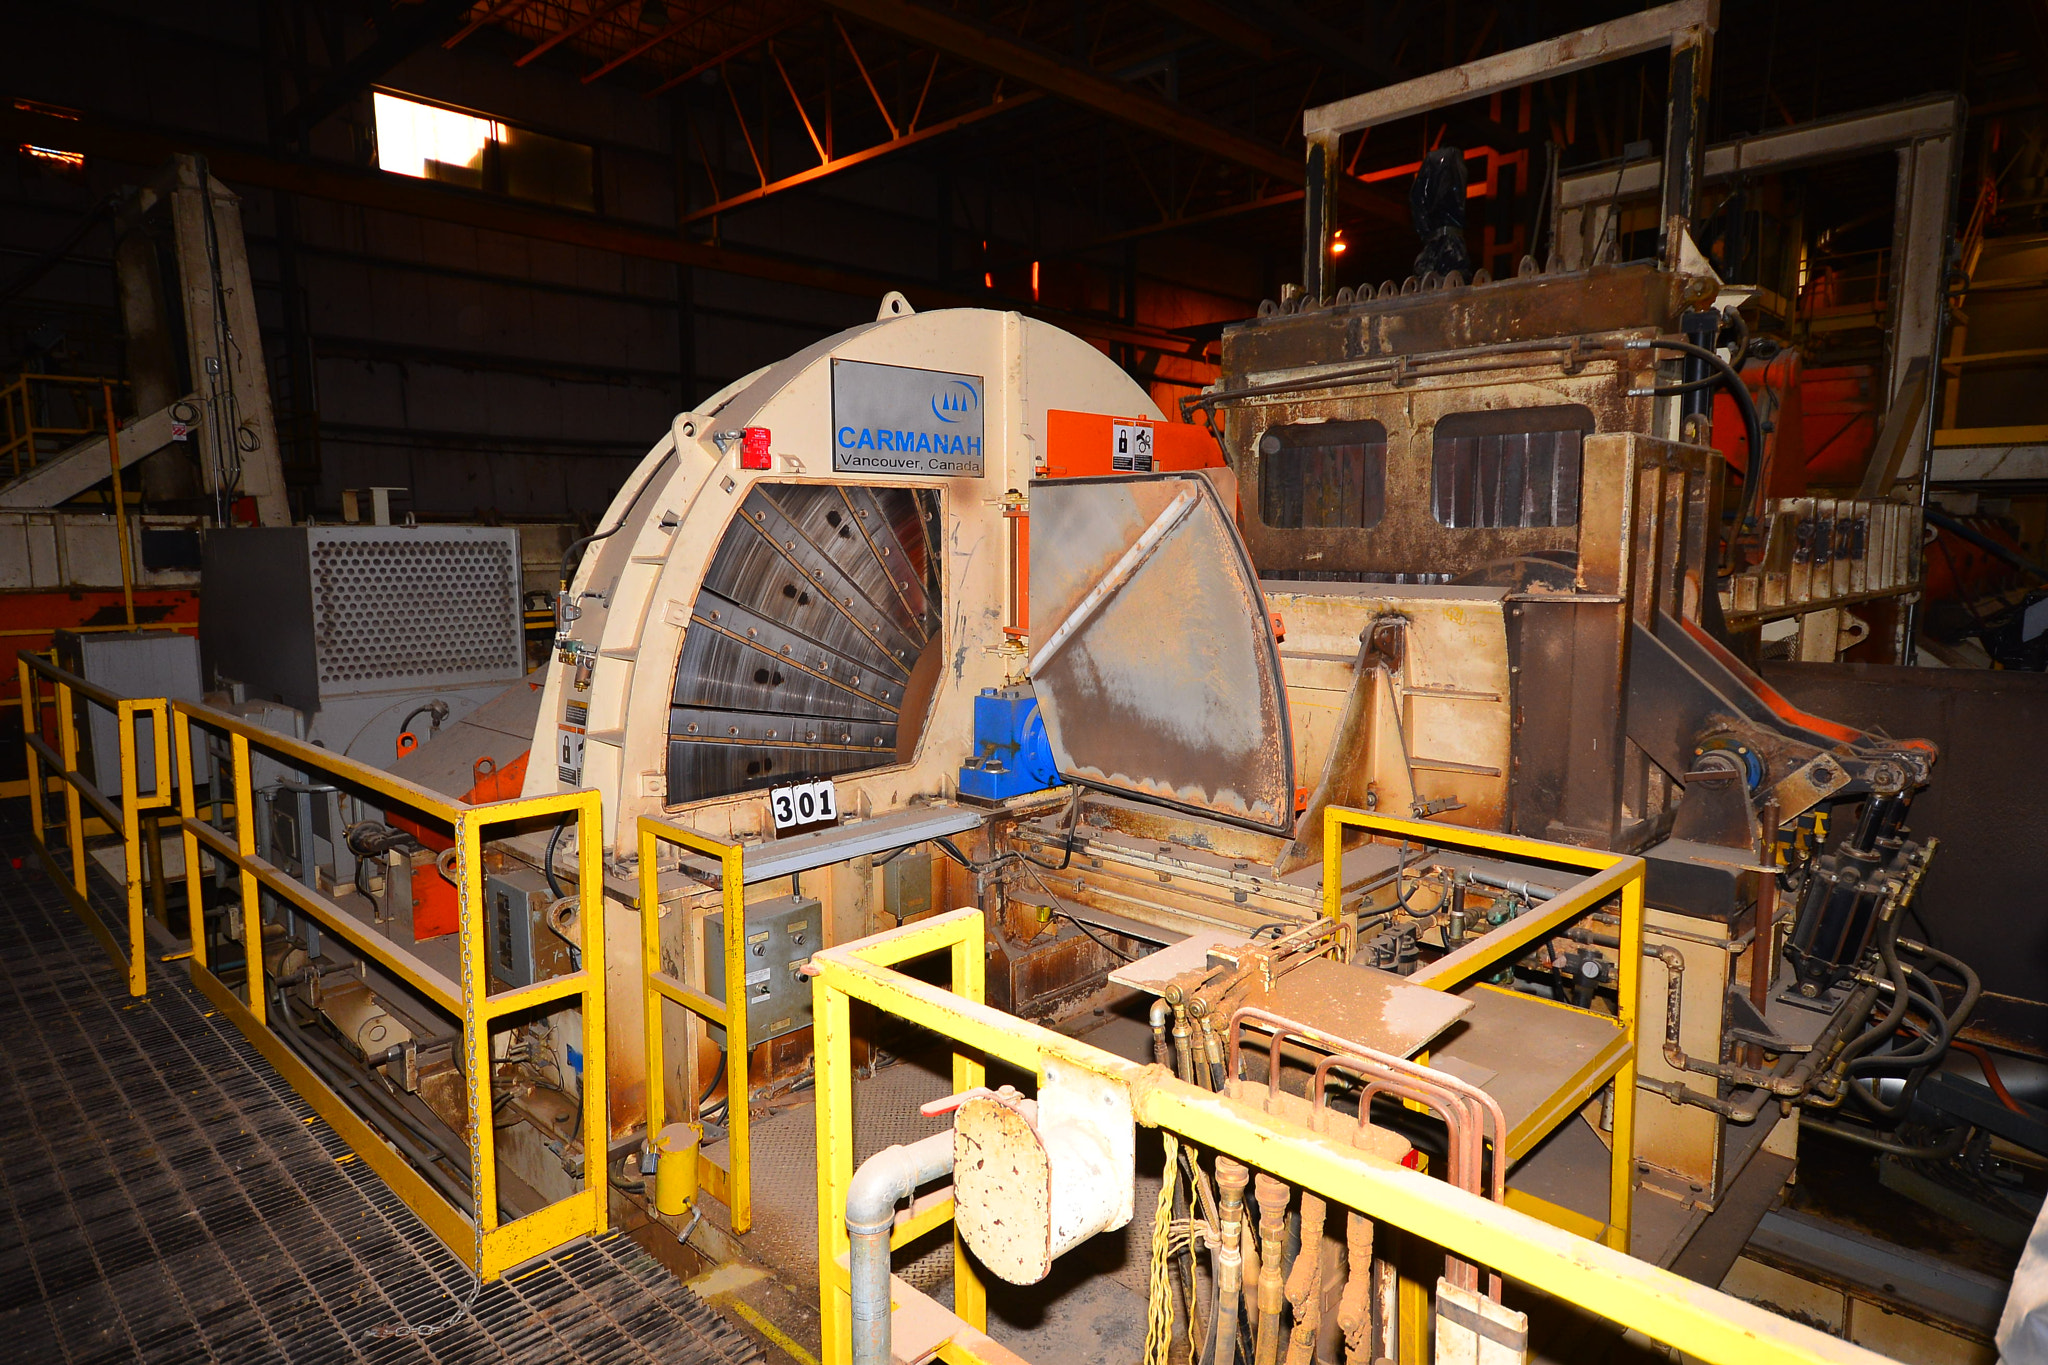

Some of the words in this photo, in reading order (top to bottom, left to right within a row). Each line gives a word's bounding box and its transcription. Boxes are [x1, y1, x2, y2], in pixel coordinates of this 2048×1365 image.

[838, 426, 981, 456] CARMANAH
[840, 453, 924, 471] Vancouver,
[928, 458, 980, 472] Canada
[776, 789, 832, 823] 301
